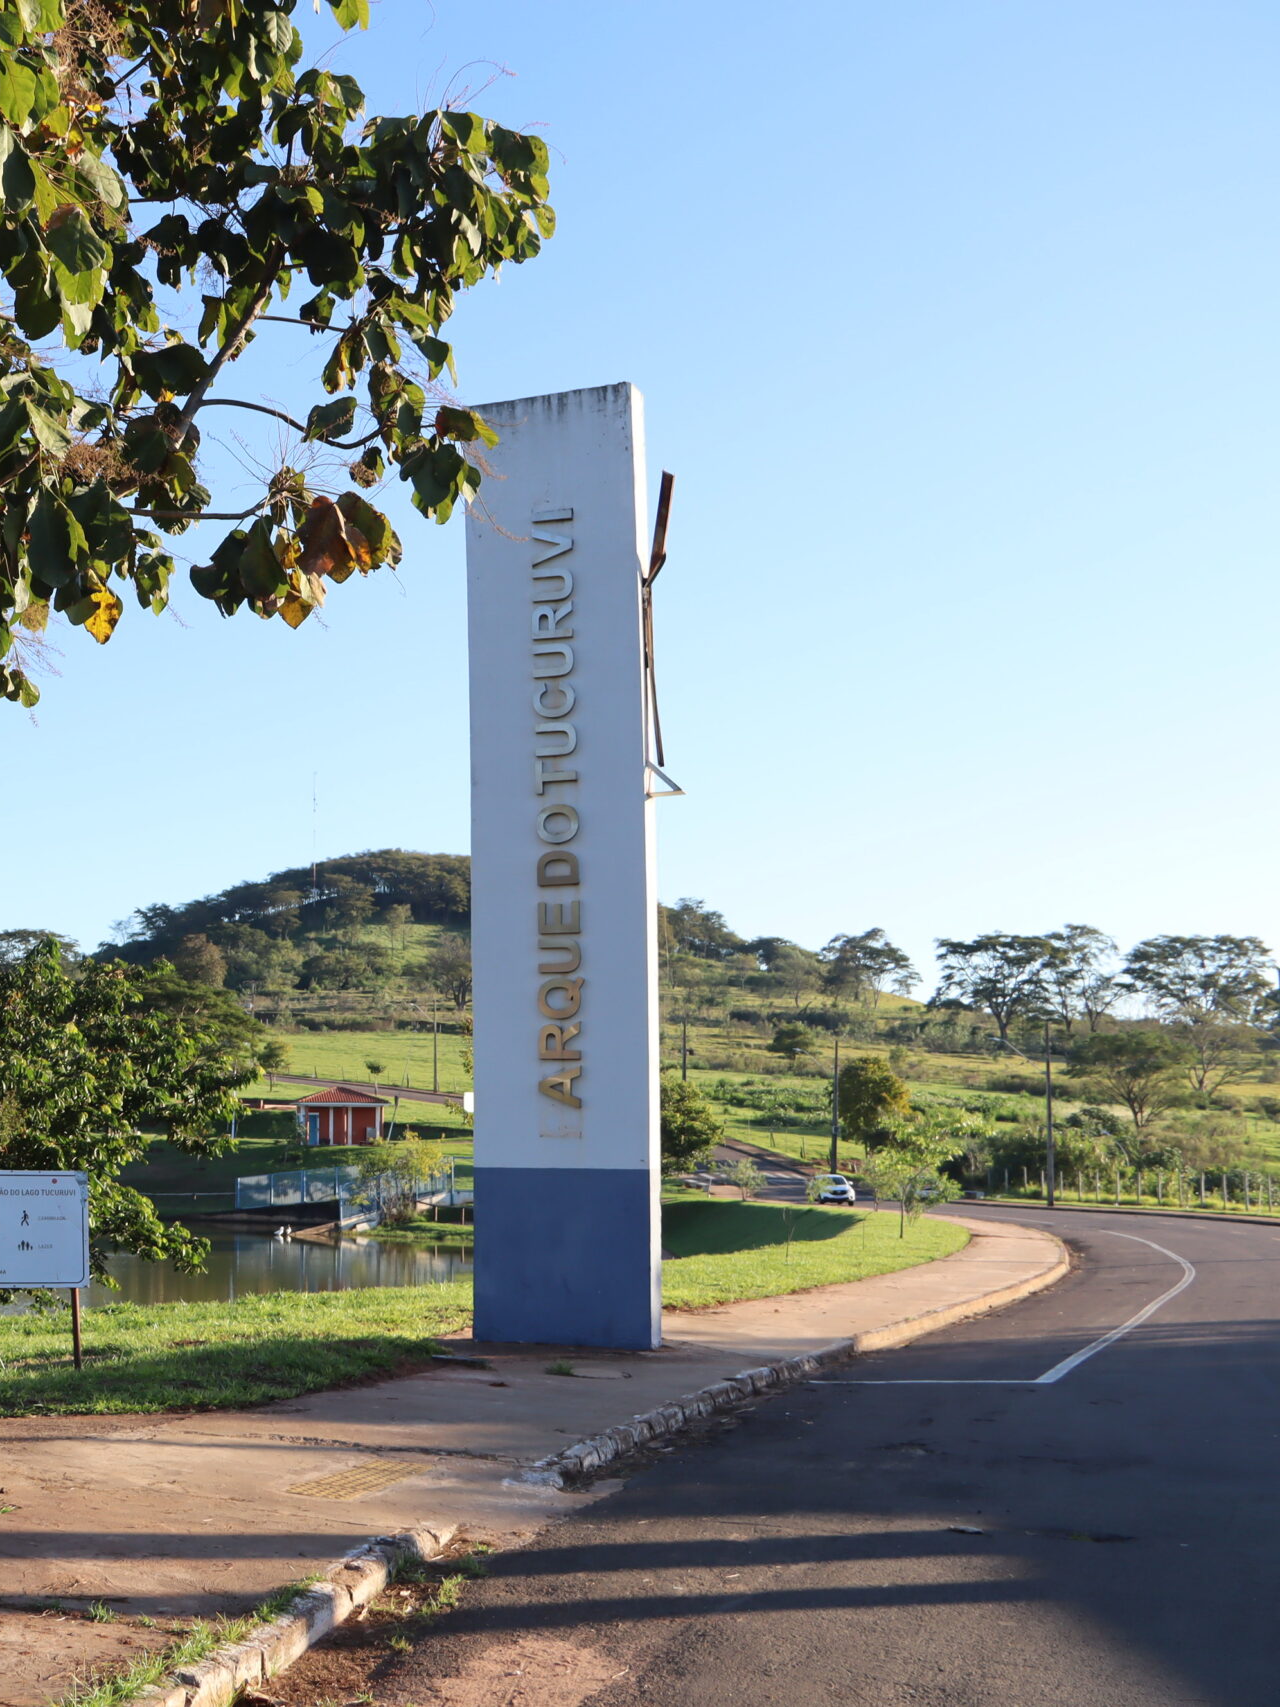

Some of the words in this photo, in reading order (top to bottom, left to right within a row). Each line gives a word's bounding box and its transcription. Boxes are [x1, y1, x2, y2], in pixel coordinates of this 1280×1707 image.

[531, 507, 577, 796] TUCURUVI
[536, 804, 580, 887] DO
[41, 1189, 76, 1197] TUCURUVI
